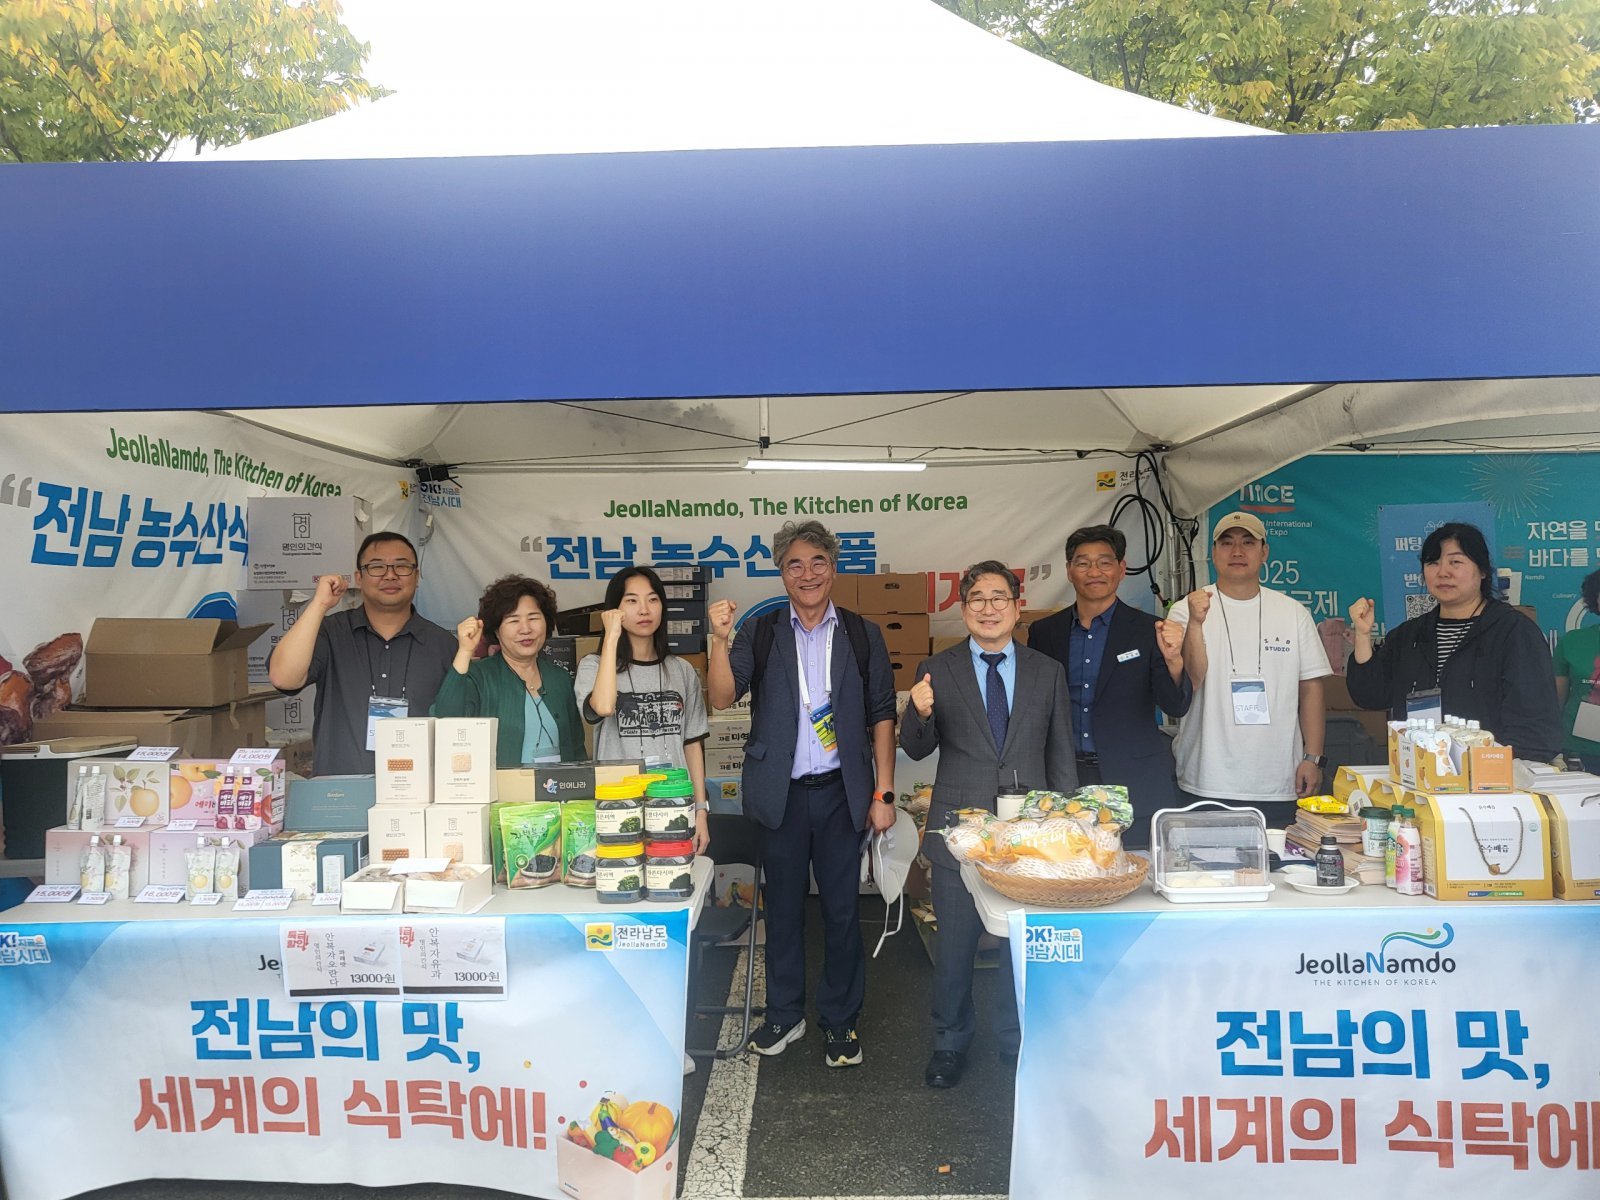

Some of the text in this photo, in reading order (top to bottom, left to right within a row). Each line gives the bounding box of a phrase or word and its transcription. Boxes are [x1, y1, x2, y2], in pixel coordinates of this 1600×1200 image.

[106, 427, 341, 497] JeollaNamdo, The Kitchen of Korea
[421, 494, 462, 508] 전남시대
[603, 493, 968, 519] JeollaNamdo, The Kitchen of Korea
[1266, 519, 1313, 528] International
[1527, 520, 1588, 541] 자연을
[1269, 529, 1288, 537] Expo
[1529, 547, 1590, 567] 바다를
[1258, 560, 1300, 584] 025
[559, 781, 586, 789] 인어나라
[0, 935, 45, 948] K! 지금은
[617, 926, 666, 940] 전라남도
[1053, 931, 1080, 942] 지금은
[1295, 951, 1456, 974] JeollaNamdo
[350, 973, 396, 984] 13000원
[454, 971, 500, 982] 13000원
[1314, 979, 1332, 987] THE
[1404, 978, 1437, 986] KOREA
[190, 998, 480, 1073] 전남의 맛,
[1217, 1009, 1550, 1090] 전남의 맛,
[134, 1076, 546, 1150] 세계의 식탁에!
[1145, 1096, 1357, 1165] 세계의
